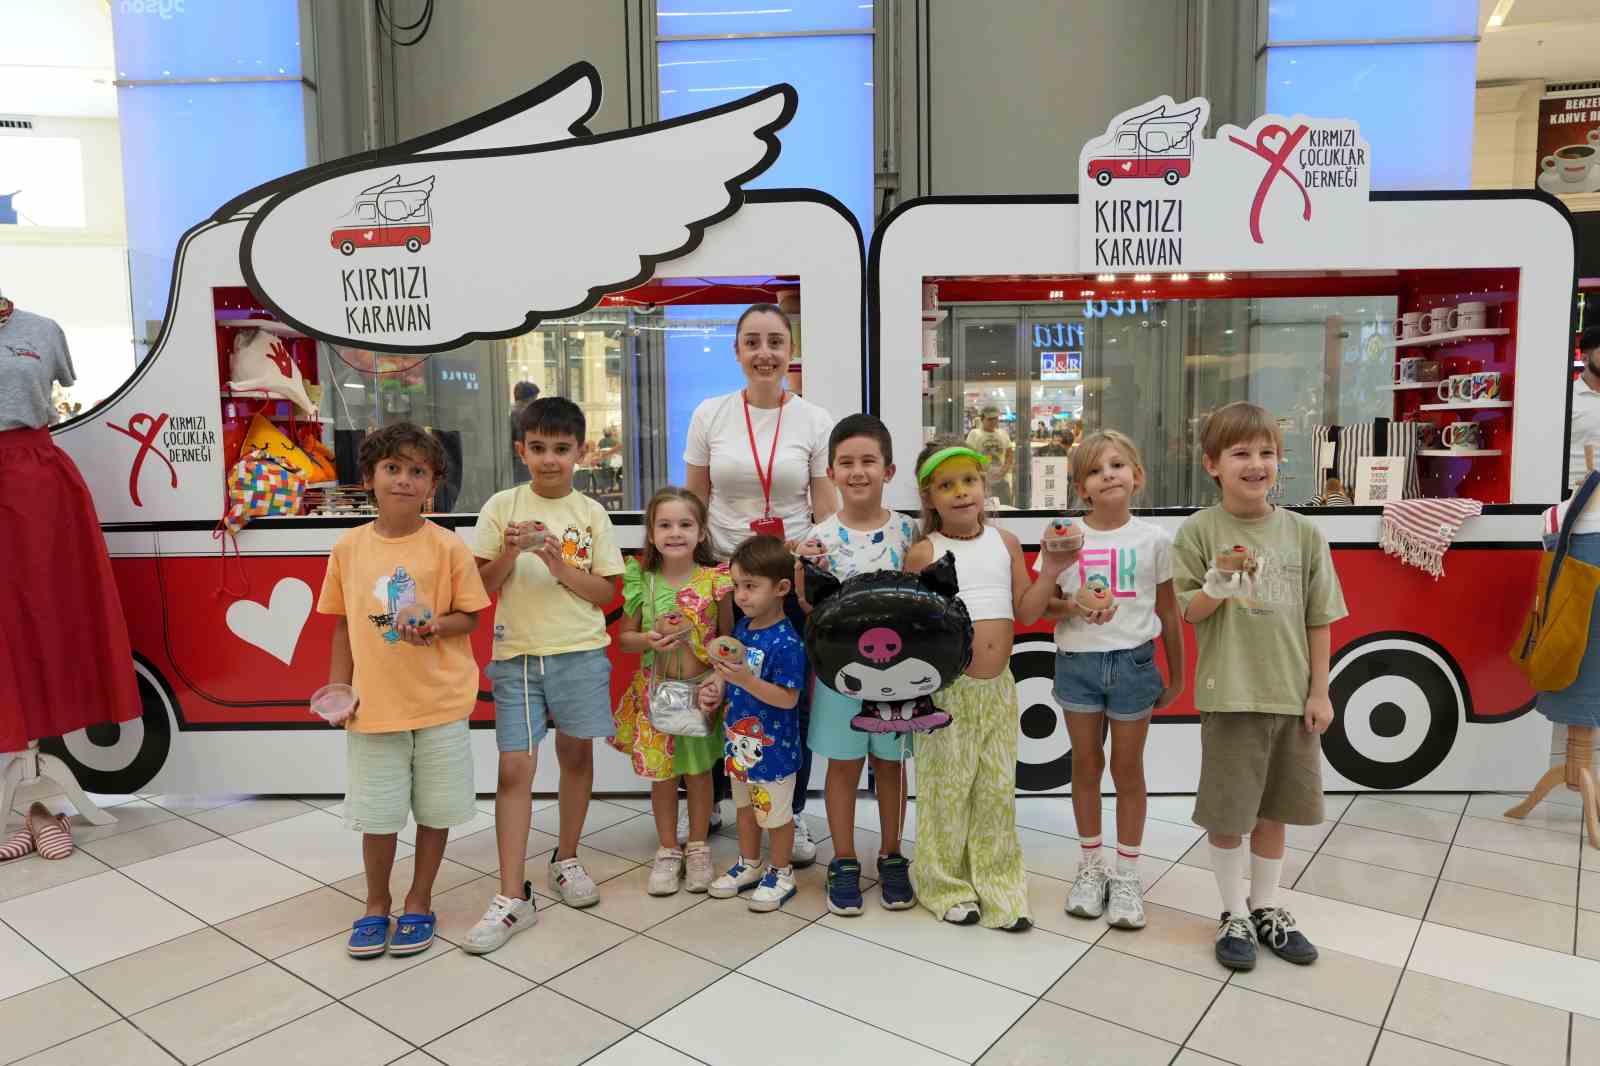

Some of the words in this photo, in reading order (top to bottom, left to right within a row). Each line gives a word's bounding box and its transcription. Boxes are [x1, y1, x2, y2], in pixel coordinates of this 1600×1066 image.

[1565, 97, 1600, 110] BENZE
[1550, 111, 1586, 125] KAHVE
[1310, 129, 1355, 147] KIRMIZI
[1299, 148, 1365, 169] ÇOCUKLAR
[1305, 166, 1357, 188] DERNEĞİ
[1096, 200, 1182, 233] KIRMIZI
[1096, 237, 1182, 266] KARAVAN
[342, 266, 428, 301] KIRMIZI
[346, 303, 431, 334] KARAVAN
[1043, 358, 1080, 373] D&R
[170, 416, 206, 430] KIRMIZI
[163, 431, 216, 448] ÇOCUKLAR
[169, 446, 211, 462] DERNEĞİ
